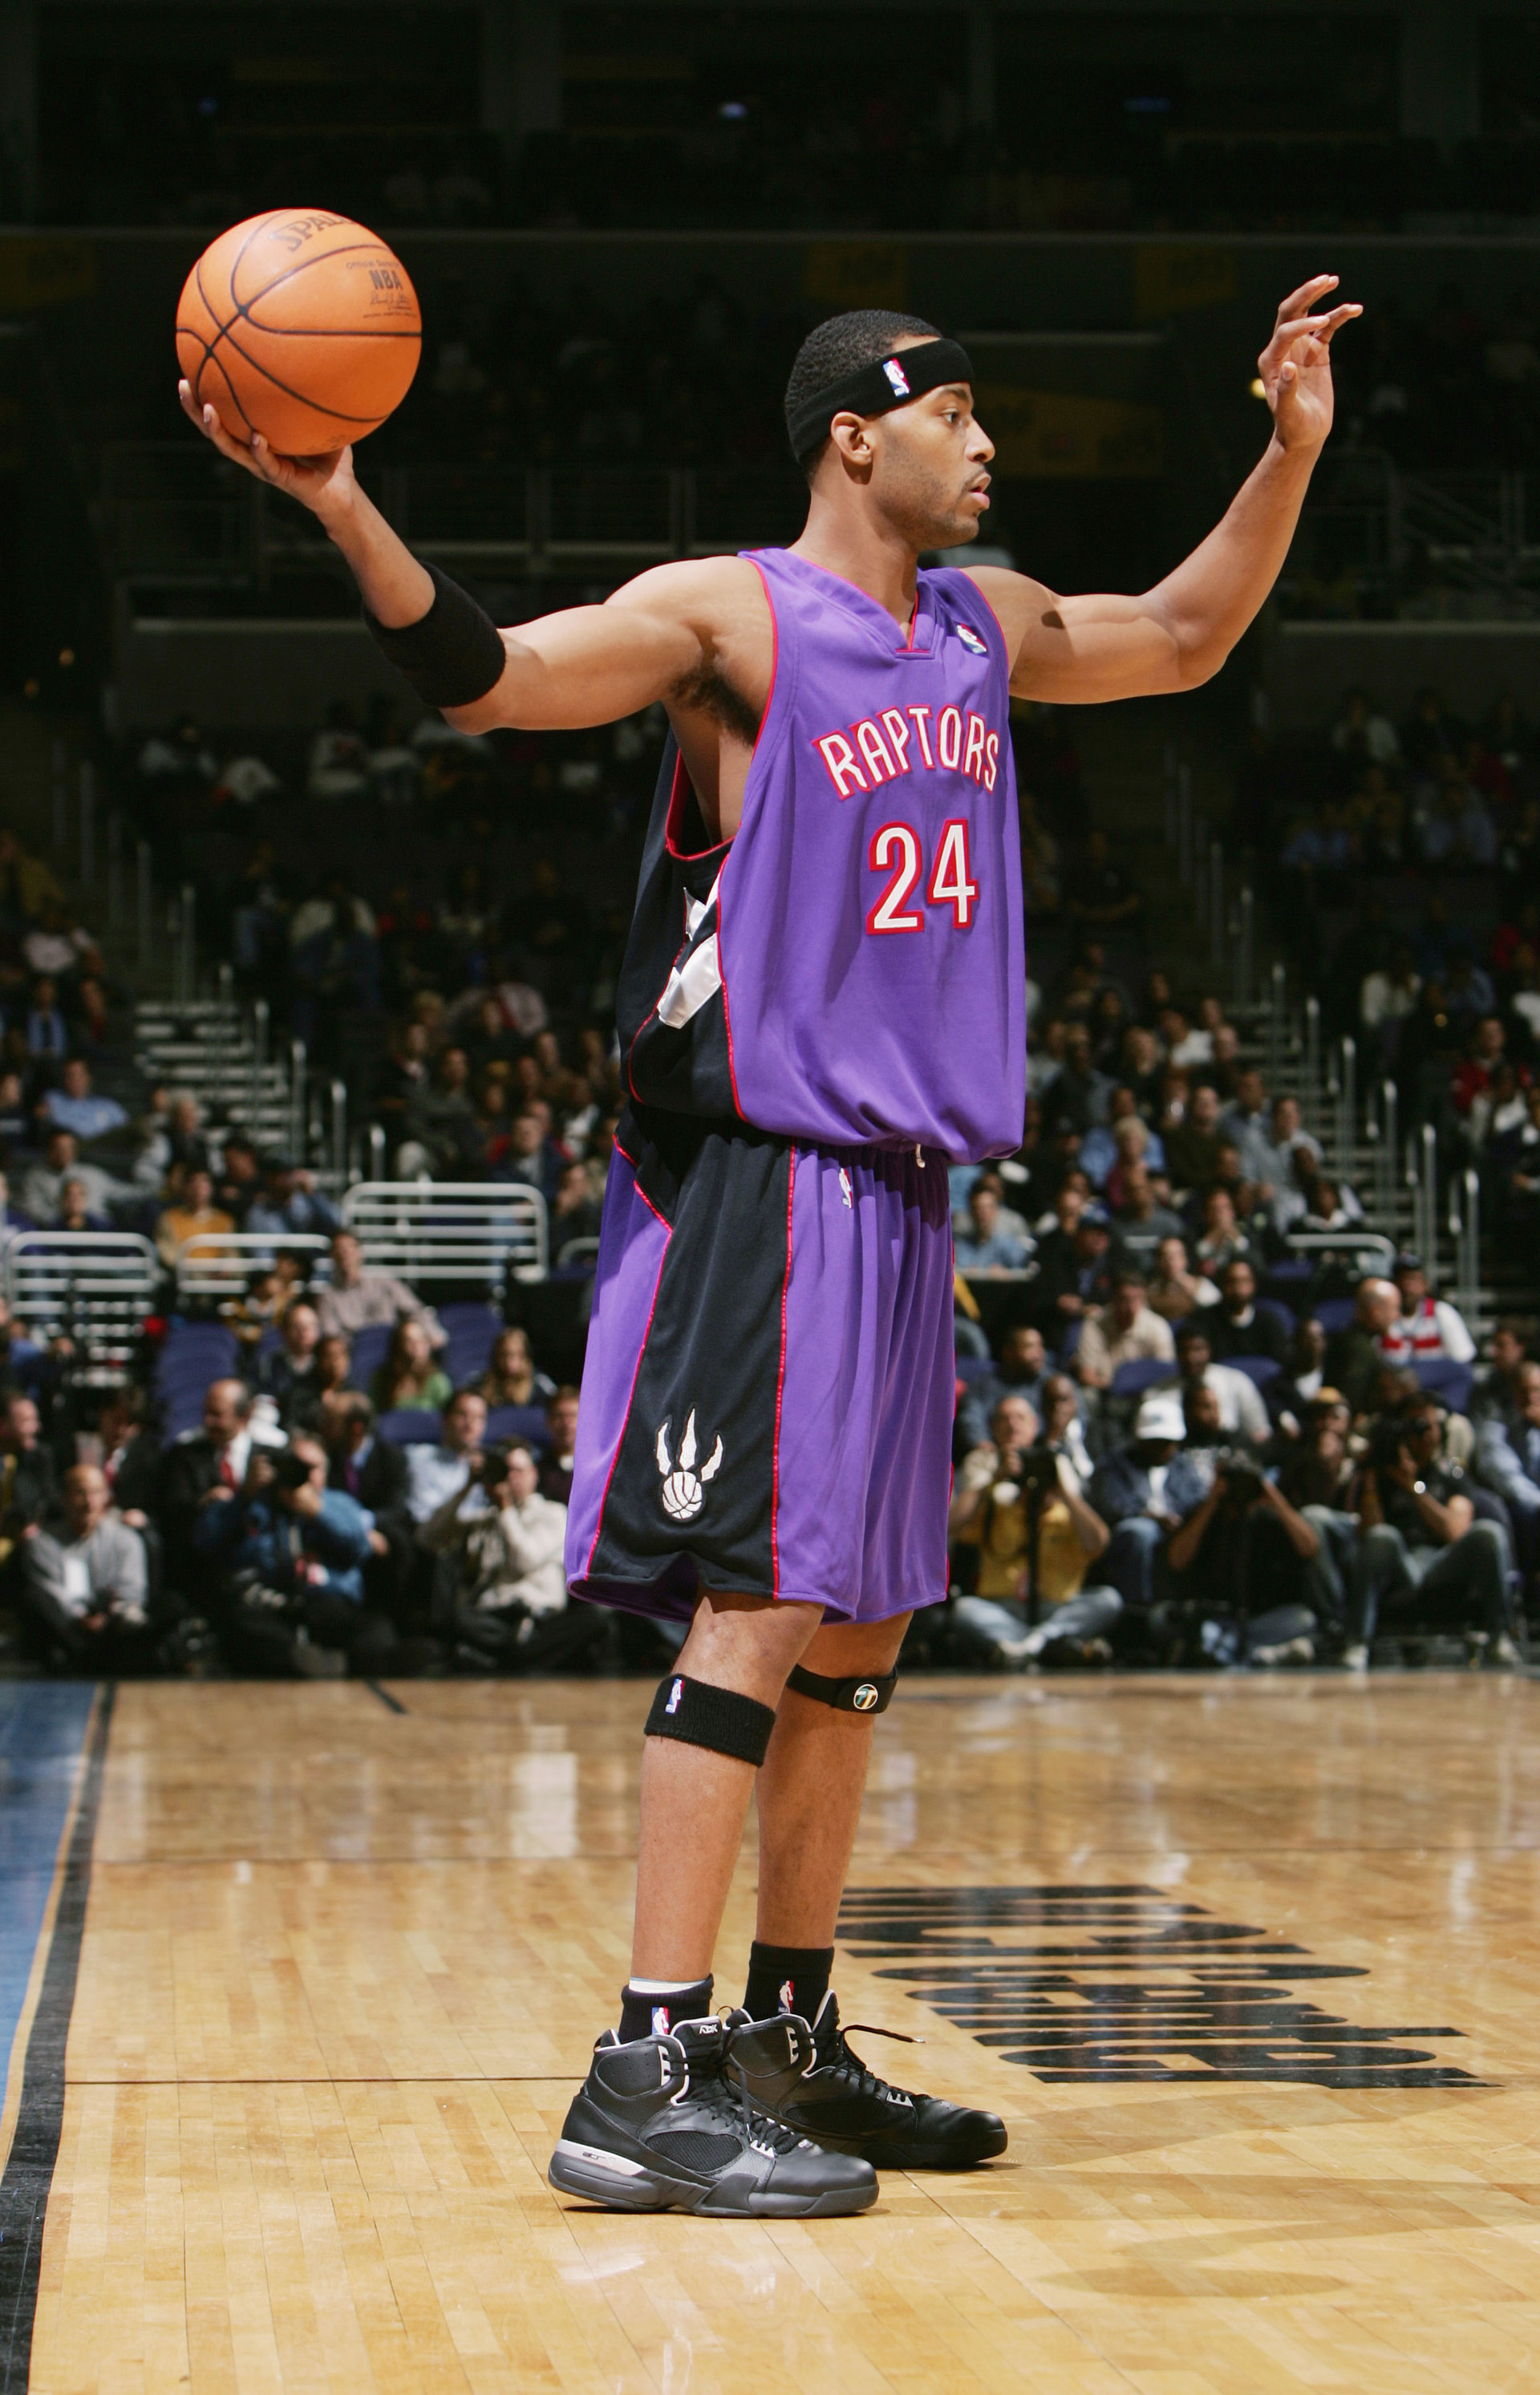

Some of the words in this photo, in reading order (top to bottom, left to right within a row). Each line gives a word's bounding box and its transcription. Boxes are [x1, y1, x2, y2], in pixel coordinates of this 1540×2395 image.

[369, 270, 403, 290] NBA
[812, 703, 1000, 800] RAPTORS
[865, 818, 979, 935] 24
[871, 1963, 1506, 2089] Center
